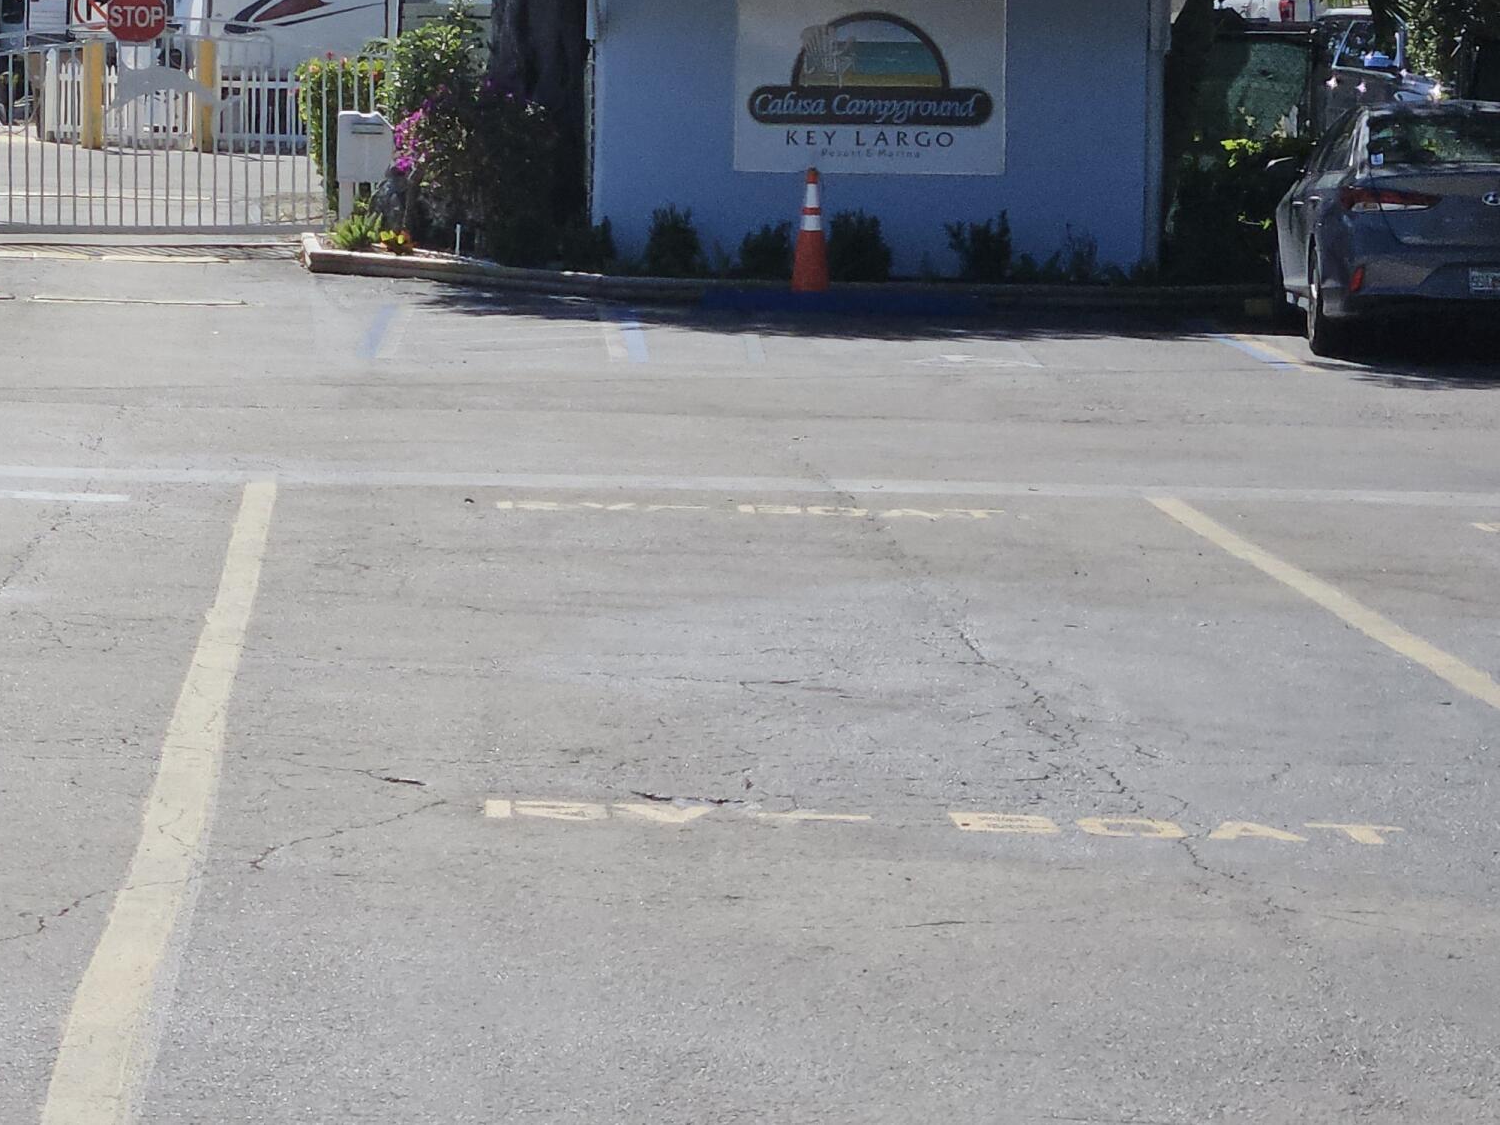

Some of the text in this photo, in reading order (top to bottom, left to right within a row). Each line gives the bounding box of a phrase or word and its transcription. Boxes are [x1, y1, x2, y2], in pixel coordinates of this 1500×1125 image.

[110, 6, 164, 28] STOP
[754, 92, 983, 124] Calusa Campground
[786, 130, 955, 148] KEY LARGO
[738, 504, 1005, 518] BOAT
[482, 798, 717, 823] RV
[948, 811, 1407, 845] BOAT
